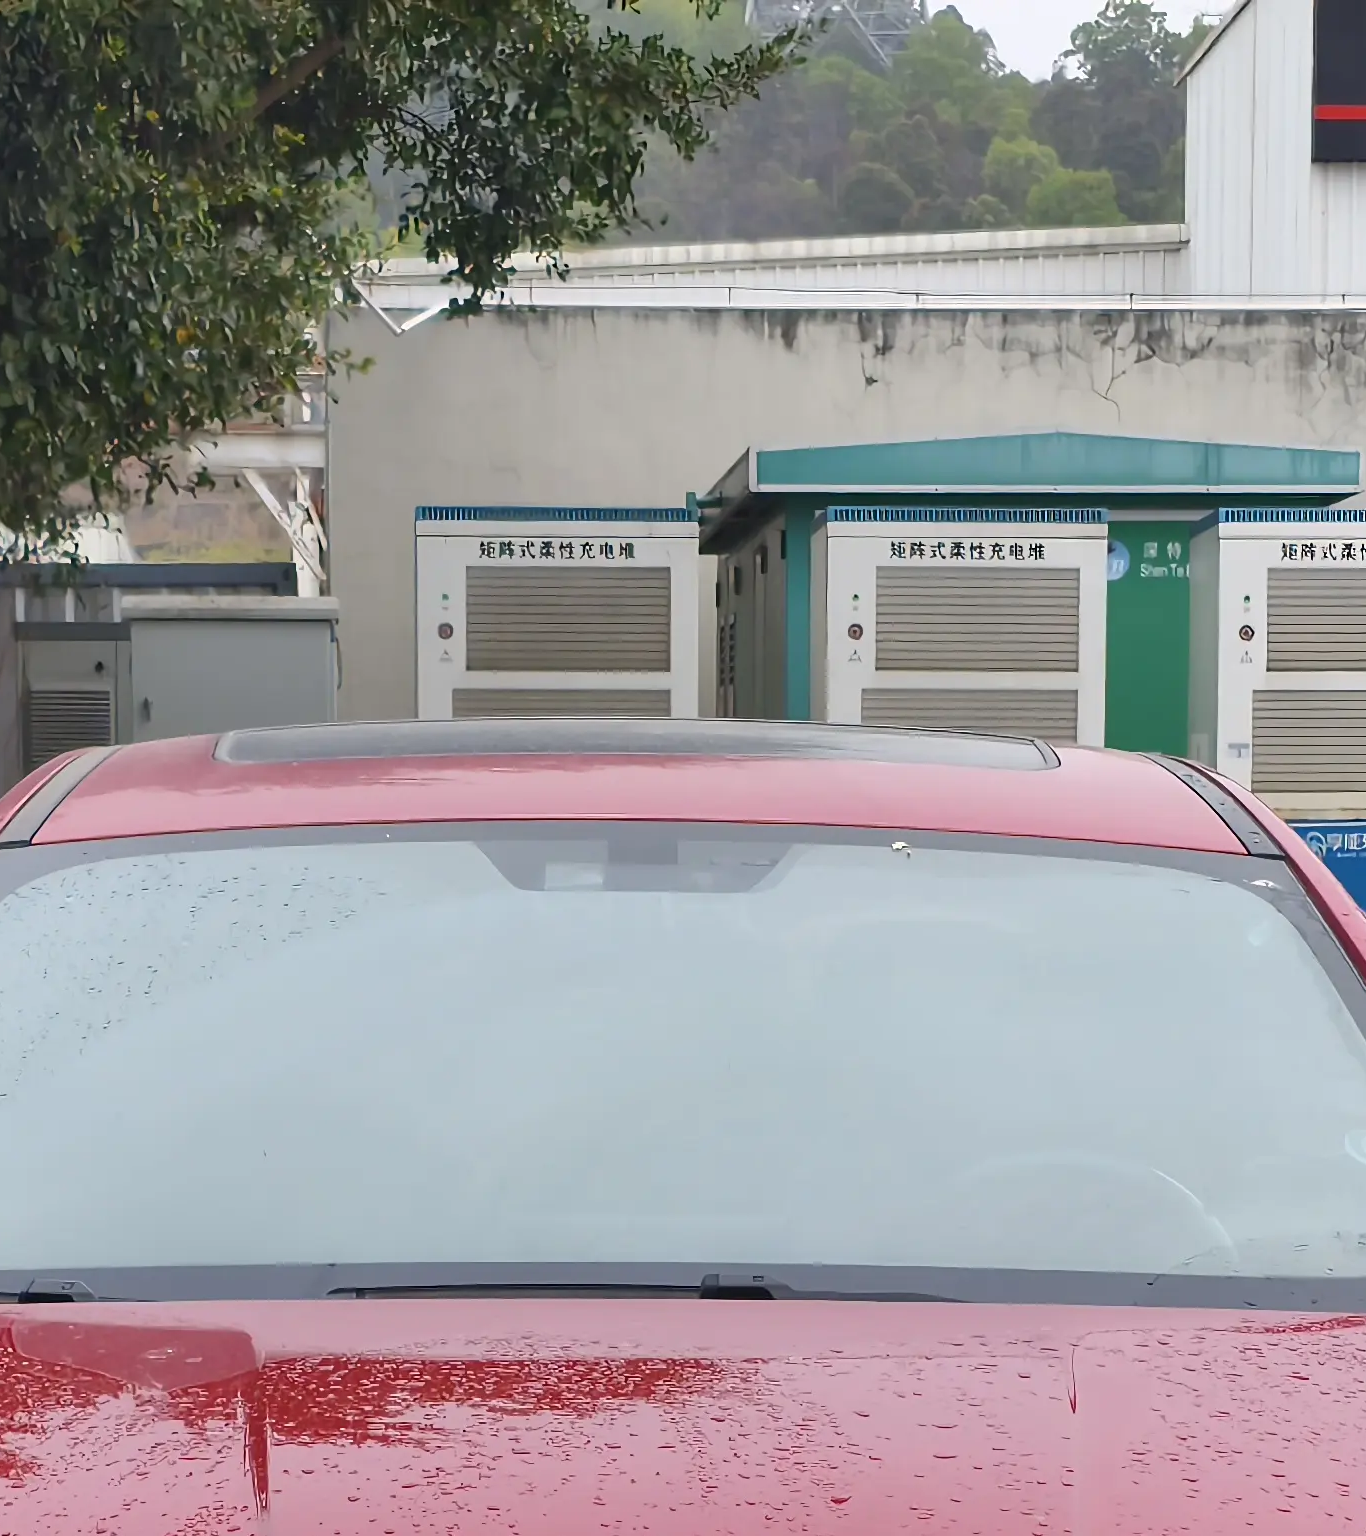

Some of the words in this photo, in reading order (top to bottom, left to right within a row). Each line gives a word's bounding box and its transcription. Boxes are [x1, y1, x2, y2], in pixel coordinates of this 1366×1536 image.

[479, 540, 635, 560] 矩阵式柔性充电堆
[890, 541, 1046, 560] 矩阵式柔性充电堆
